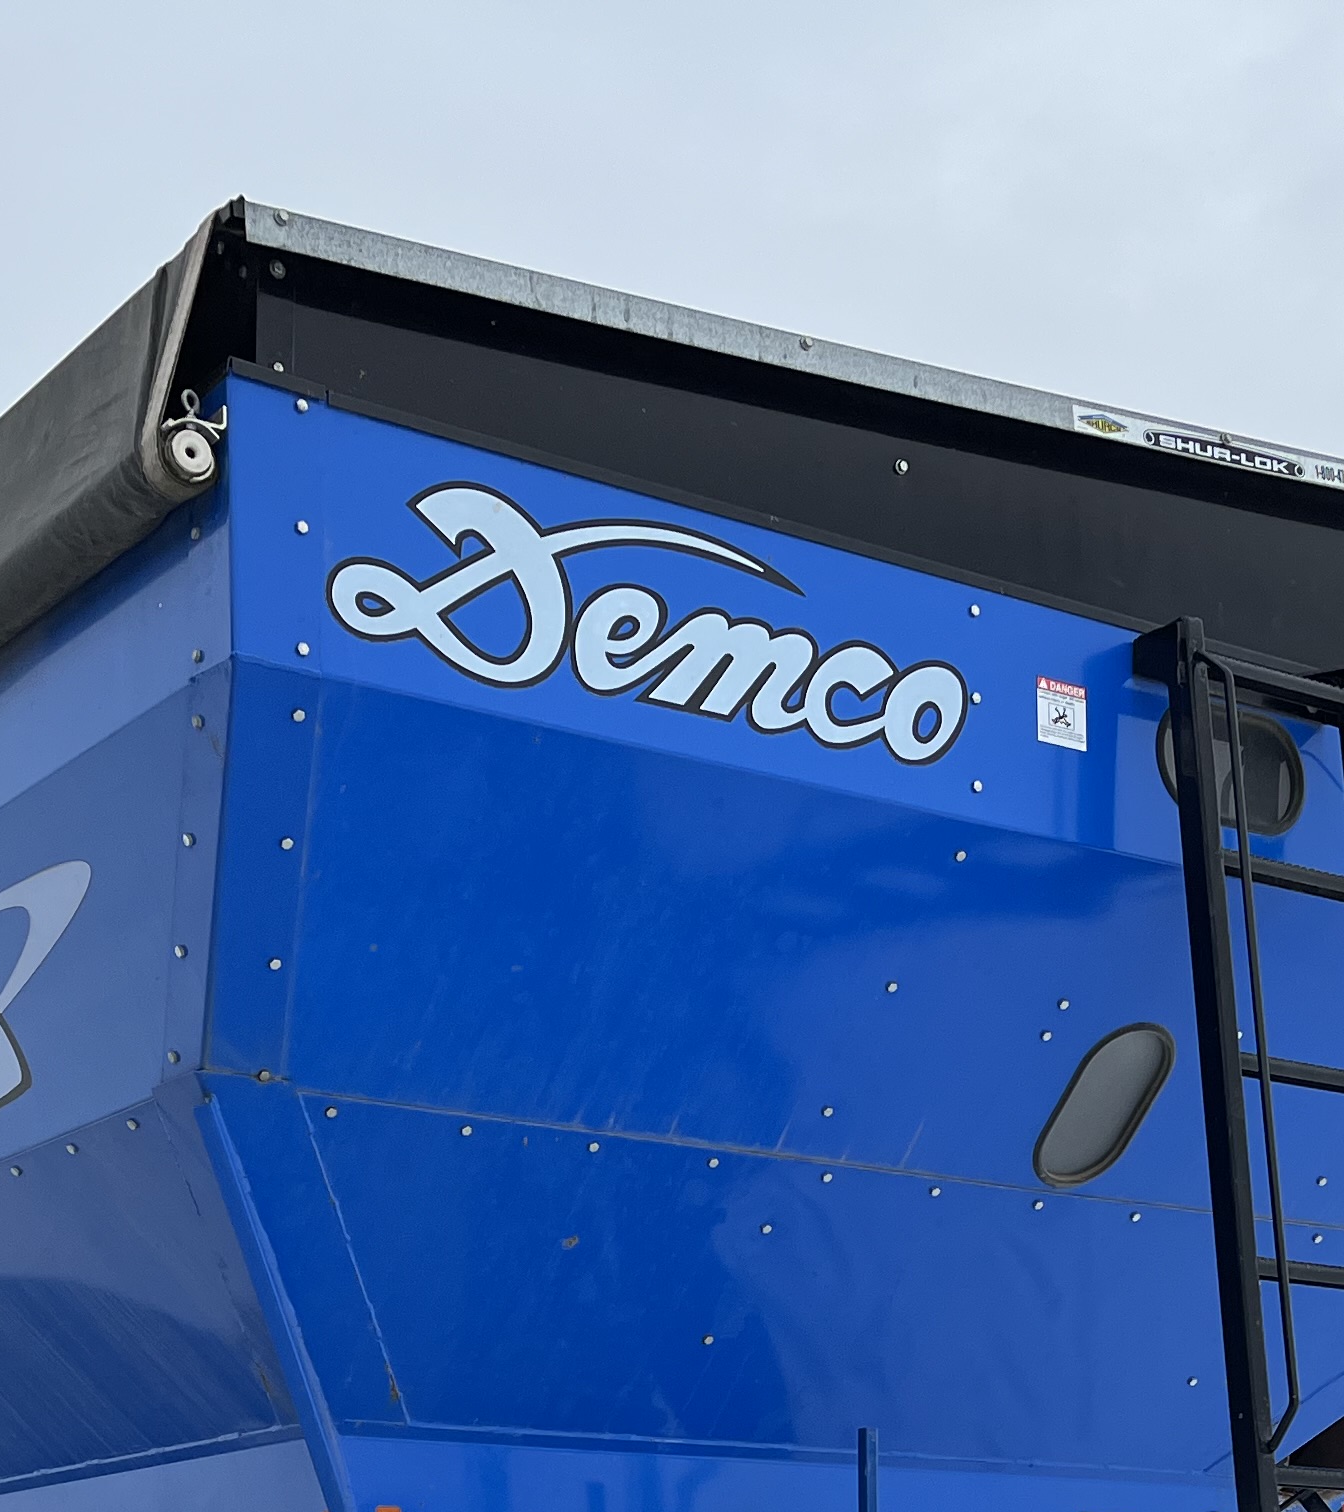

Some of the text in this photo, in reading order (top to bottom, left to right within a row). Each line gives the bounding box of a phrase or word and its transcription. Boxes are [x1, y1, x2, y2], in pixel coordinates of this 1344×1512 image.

[1159, 434, 1289, 474] SHUR-LOK
[326, 481, 969, 765] Demco
[1049, 681, 1085, 698] DANGER
